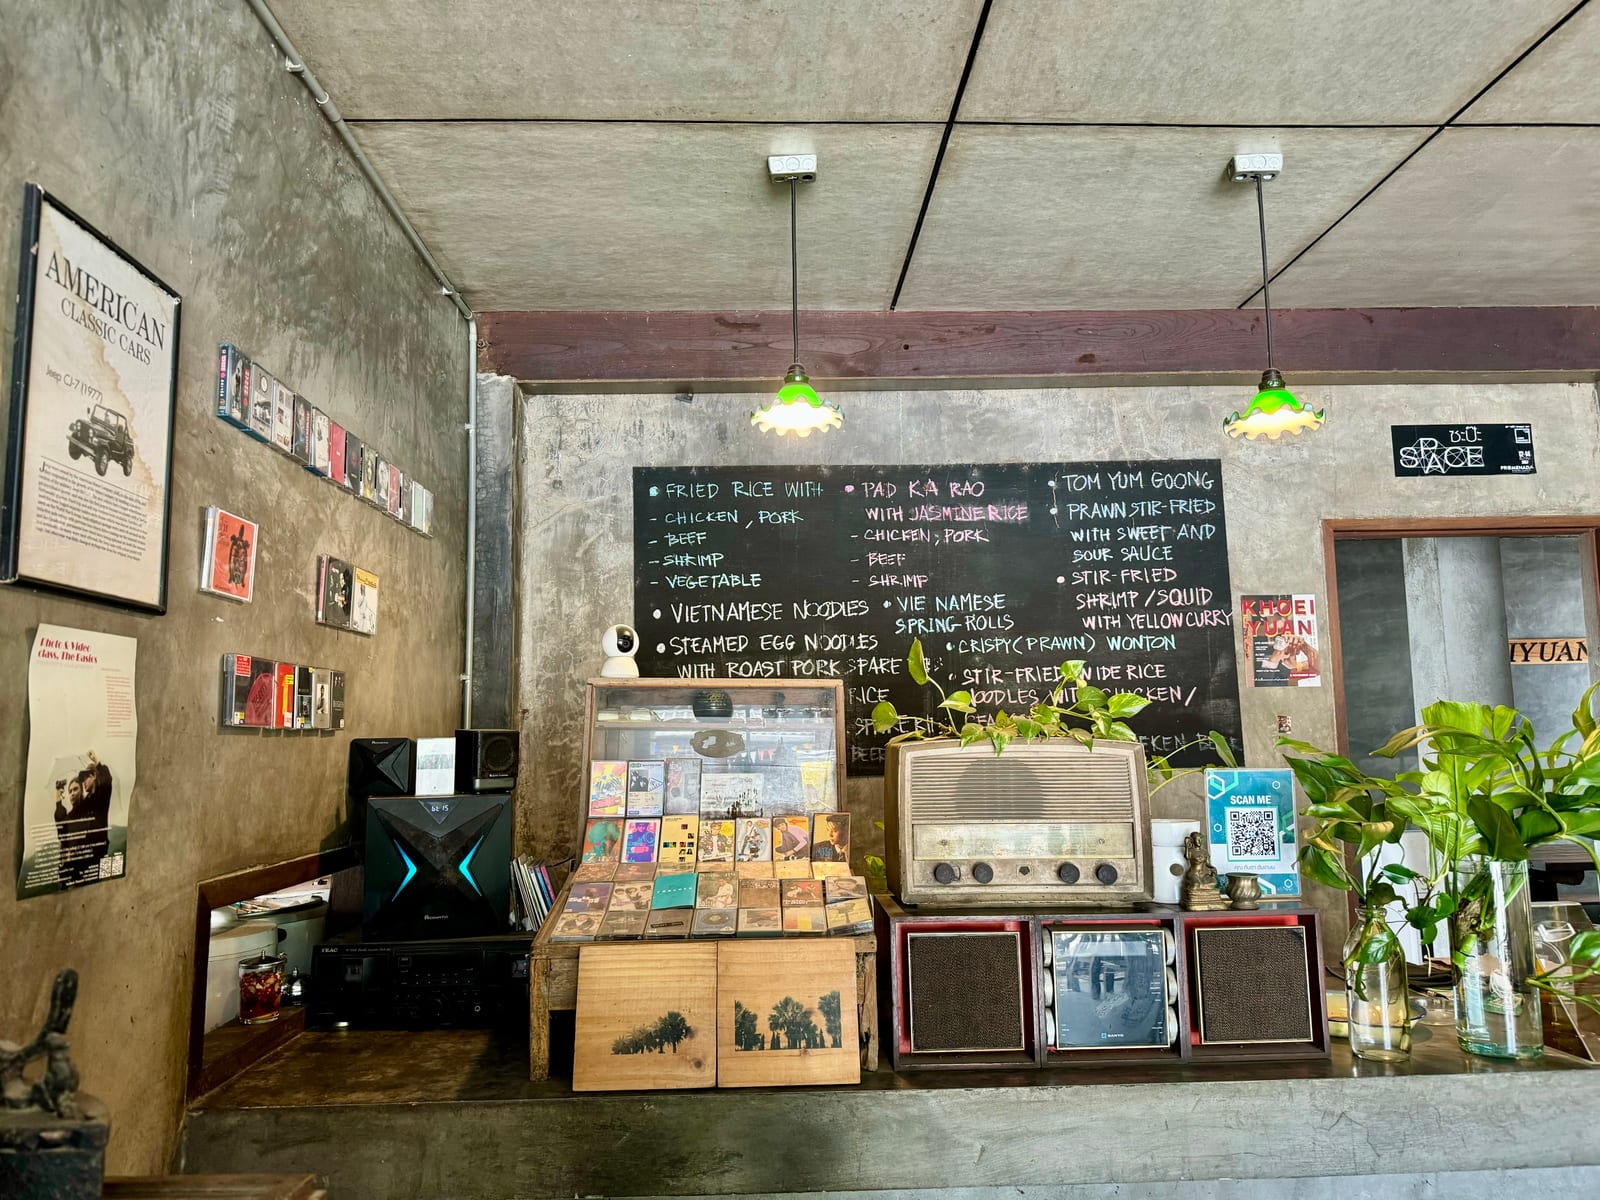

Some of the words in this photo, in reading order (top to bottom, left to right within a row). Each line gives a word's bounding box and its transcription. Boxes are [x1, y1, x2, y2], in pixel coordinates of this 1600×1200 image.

[45, 250, 166, 351] AMERICAN
[61, 297, 116, 344] CLASSIC
[119, 333, 151, 366] CARS
[1400, 437, 1485, 474] SPACE
[667, 482, 719, 498] FRIED
[731, 481, 773, 498] RICE
[785, 481, 823, 498] WITH
[862, 482, 896, 498] PAD
[909, 478, 939, 498] KA
[950, 481, 985, 498] RAO
[1062, 473, 1101, 492] TOM
[1107, 471, 1144, 490] YUM
[1151, 471, 1214, 490] GOONG
[758, 510, 804, 525] PORK
[865, 506, 904, 522] WITH
[908, 505, 985, 522] JASMINE
[988, 504, 1029, 521] RICE
[1066, 502, 1126, 520] PRAWN
[1129, 499, 1216, 518] STIR-FRIED
[664, 532, 707, 547] BEEF
[944, 529, 989, 544] PORK
[1070, 527, 1110, 542] WITH
[1117, 525, 1172, 542] SWEET
[1177, 523, 1216, 541] AND
[662, 552, 724, 568] SHRIMP
[865, 552, 906, 567] BEEF
[1072, 549, 1114, 563] SOUR
[1121, 546, 1173, 562] SAUCE
[665, 573, 762, 589] VEGETABLE
[868, 574, 929, 589] SHRIMP
[1071, 567, 1177, 585] STIR-FRIED
[1076, 591, 1139, 610] SHRIMP
[1241, 599, 1315, 616] KHOEI
[670, 601, 783, 623] VIETNAMESE
[793, 599, 870, 619] NOODLES
[1082, 614, 1120, 630] WITH
[1127, 613, 1183, 629] YELLOW
[1186, 609, 1233, 628] CURRY
[895, 616, 961, 635] SPRING
[964, 614, 1015, 632] ROLLS
[1248, 620, 1312, 636] YUAN
[669, 634, 749, 656] STEAMED
[759, 635, 796, 651] EGG
[1105, 634, 1177, 652] WONTON
[676, 662, 715, 678] WITH
[725, 660, 785, 678] ROAST
[792, 660, 840, 677] PORK
[848, 657, 901, 676] SPARE
[1126, 664, 1168, 680] RICE
[1230, 795, 1255, 805] SCAN
[1257, 795, 1272, 804] ME
